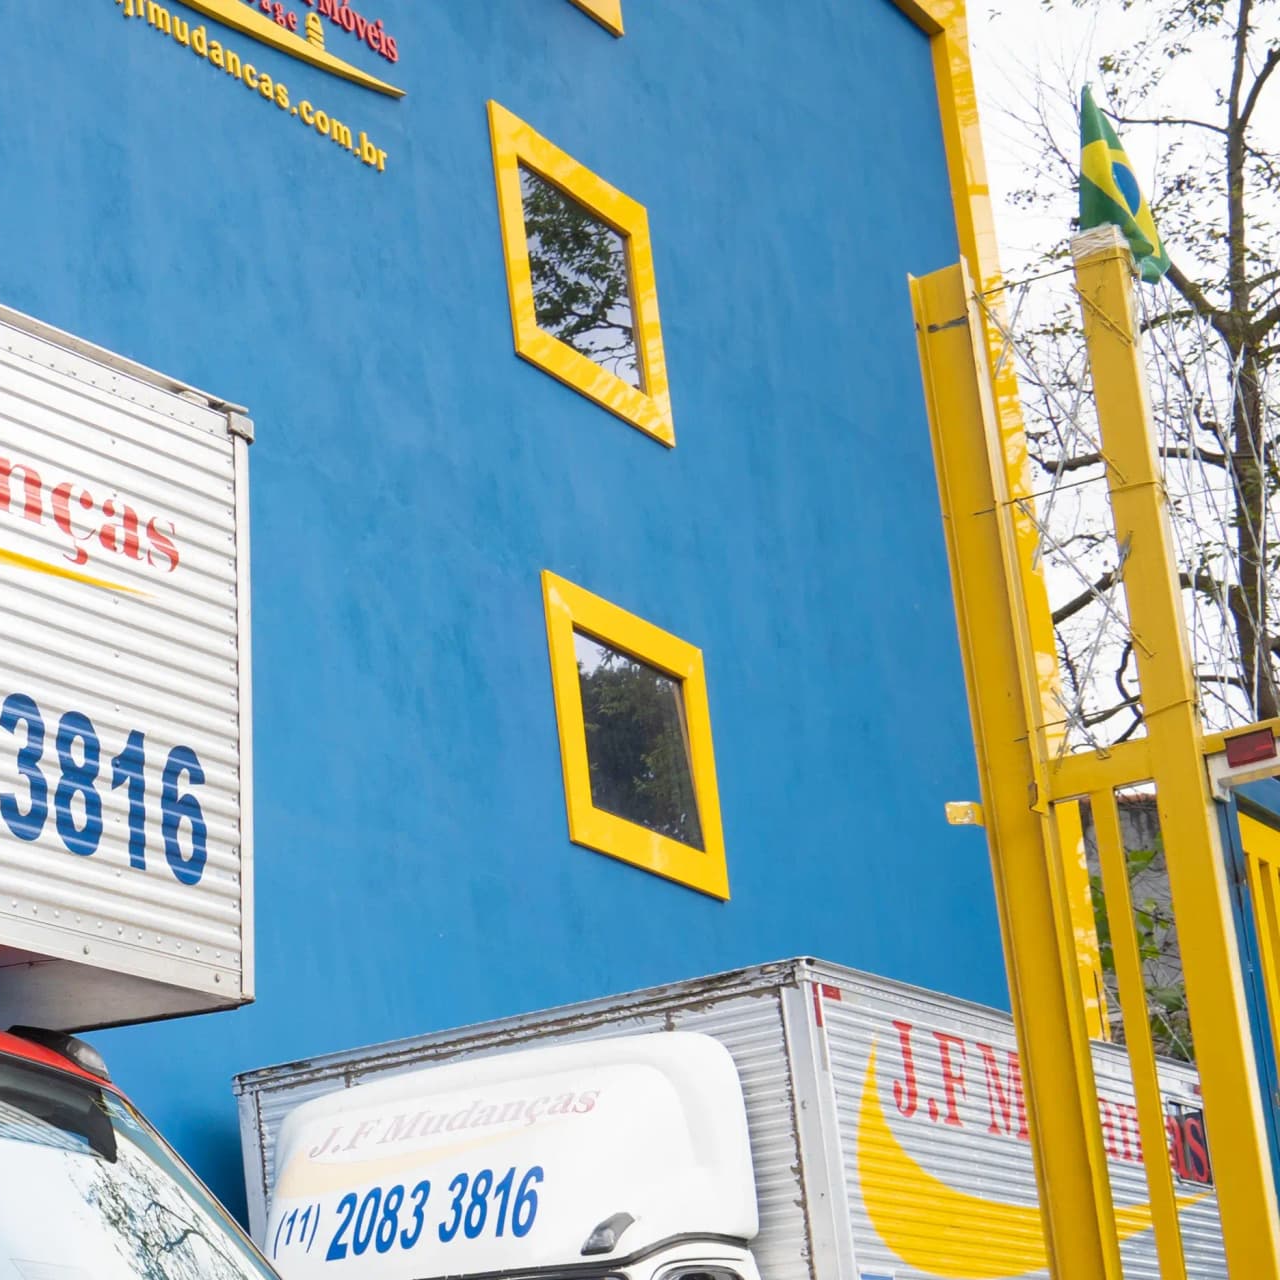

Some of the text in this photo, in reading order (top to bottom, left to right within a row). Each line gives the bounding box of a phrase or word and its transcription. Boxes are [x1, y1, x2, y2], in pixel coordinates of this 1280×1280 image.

[376, 1089, 601, 1146] Mudanças
[273, 1165, 544, 1262] (11) 2083 3816
